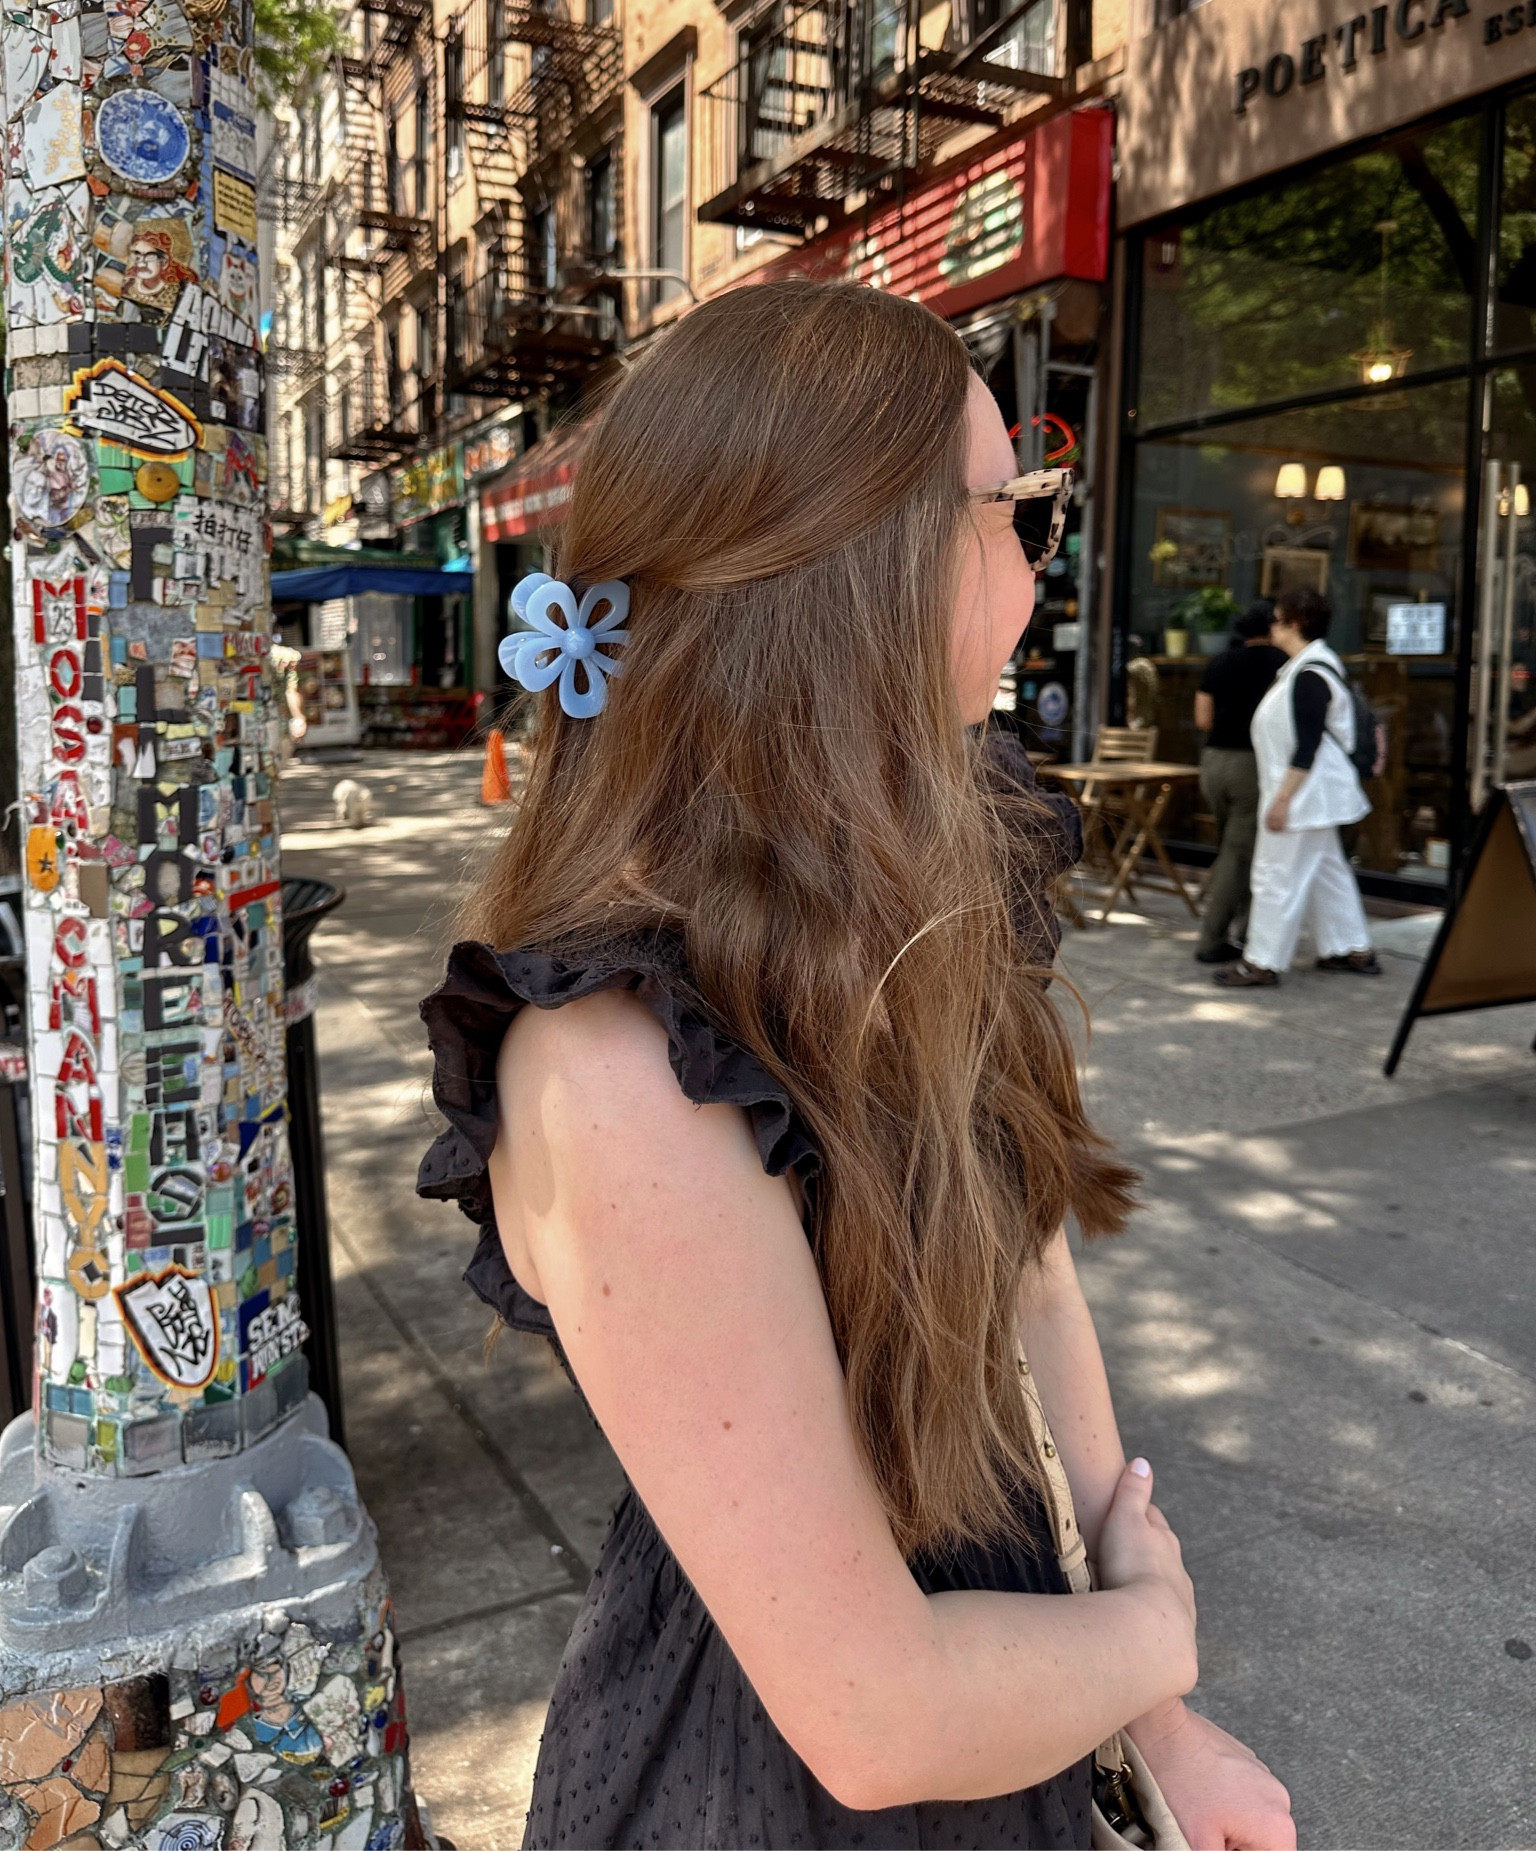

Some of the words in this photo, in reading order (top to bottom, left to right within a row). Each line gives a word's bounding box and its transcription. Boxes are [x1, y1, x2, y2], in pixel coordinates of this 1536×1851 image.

[1234, 0, 1470, 116] POETICA
[50, 603, 74, 638] 25
[50, 976, 103, 1142] MAN
